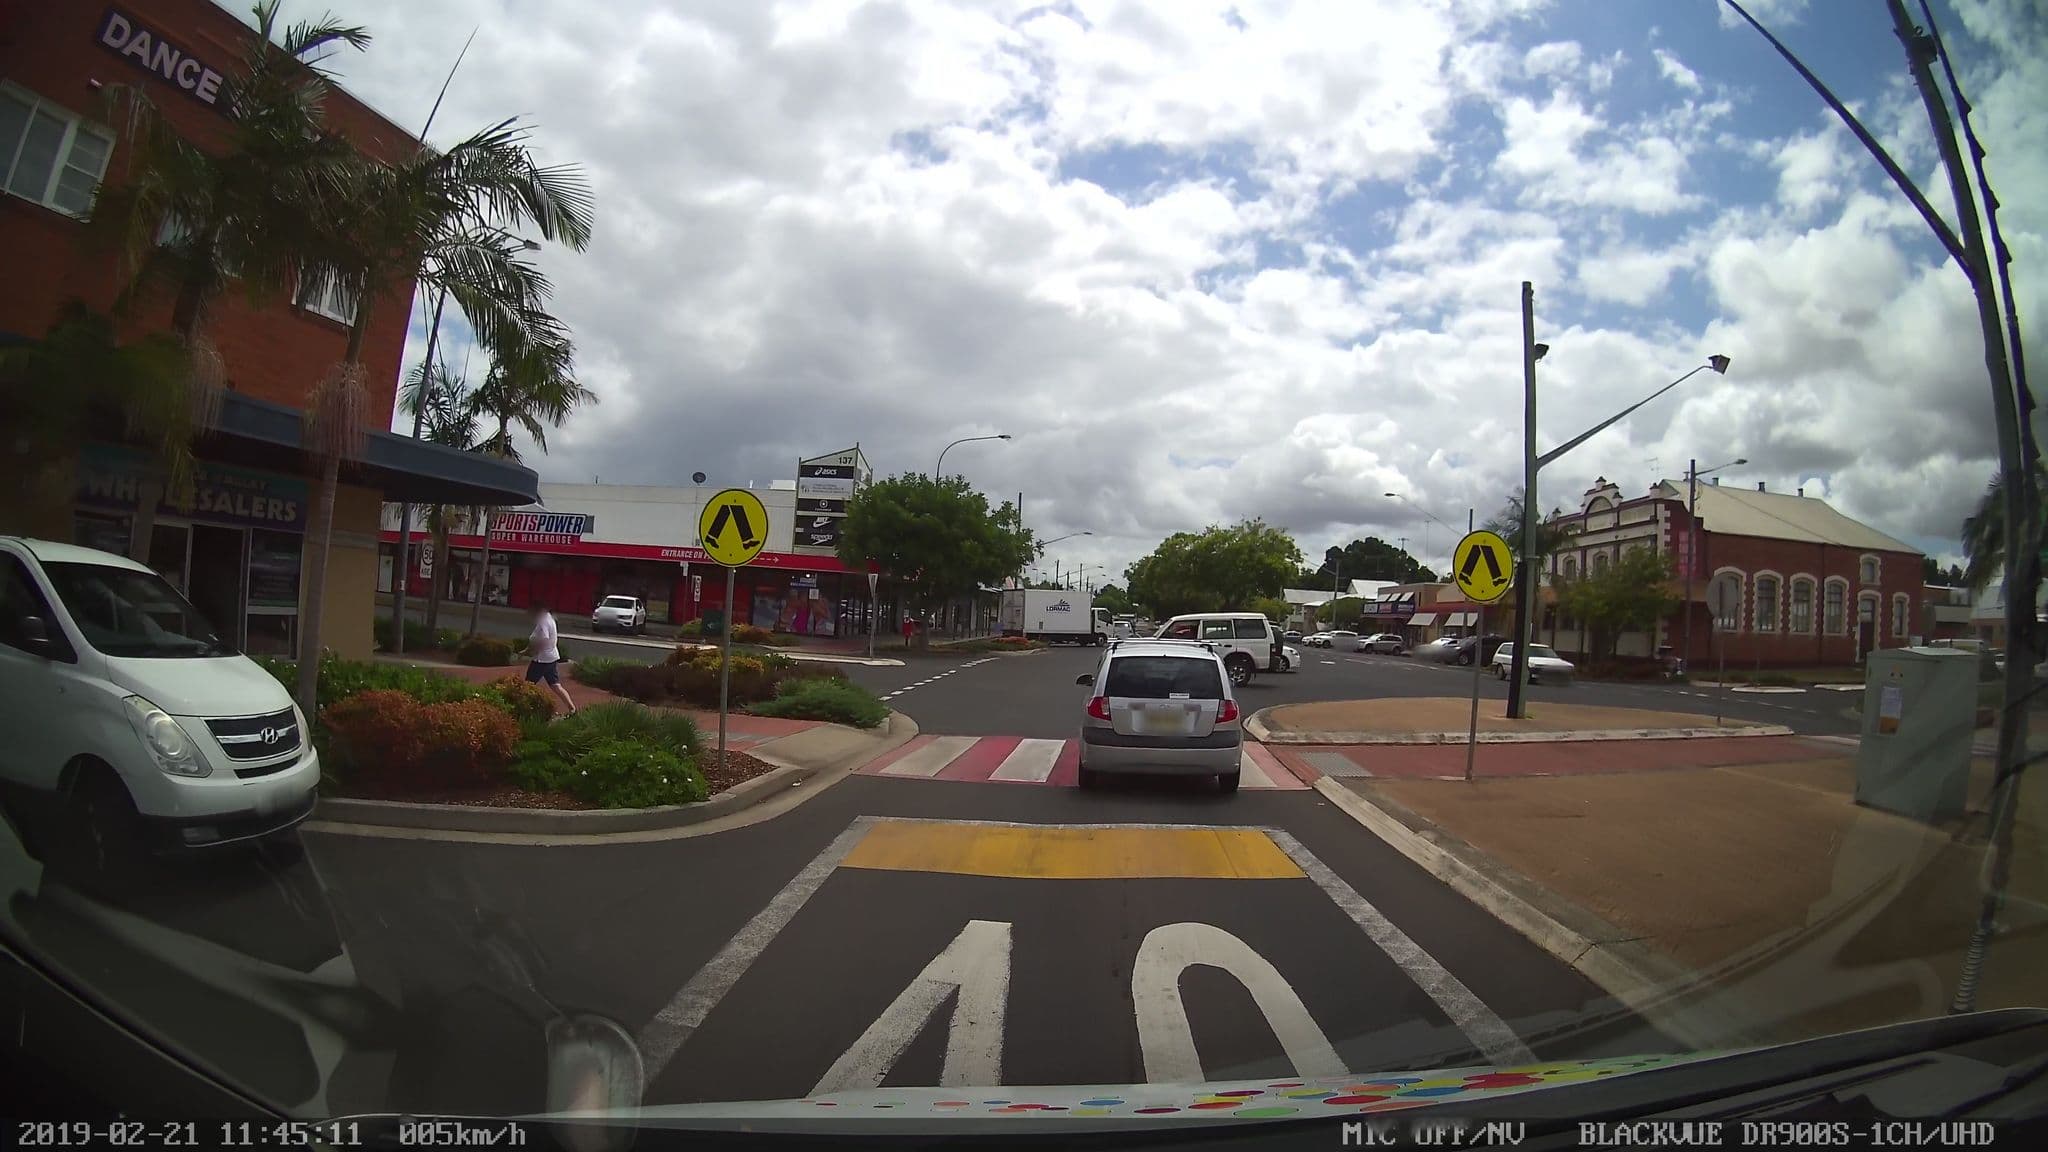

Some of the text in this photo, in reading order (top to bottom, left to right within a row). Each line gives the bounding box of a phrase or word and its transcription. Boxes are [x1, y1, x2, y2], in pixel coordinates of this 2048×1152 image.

[102, 12, 223, 105] DANCE
[838, 457, 853, 465] 137
[492, 532, 572, 545] SUPER WAREHOUSE
[661, 549, 694, 559] ENTRANCE
